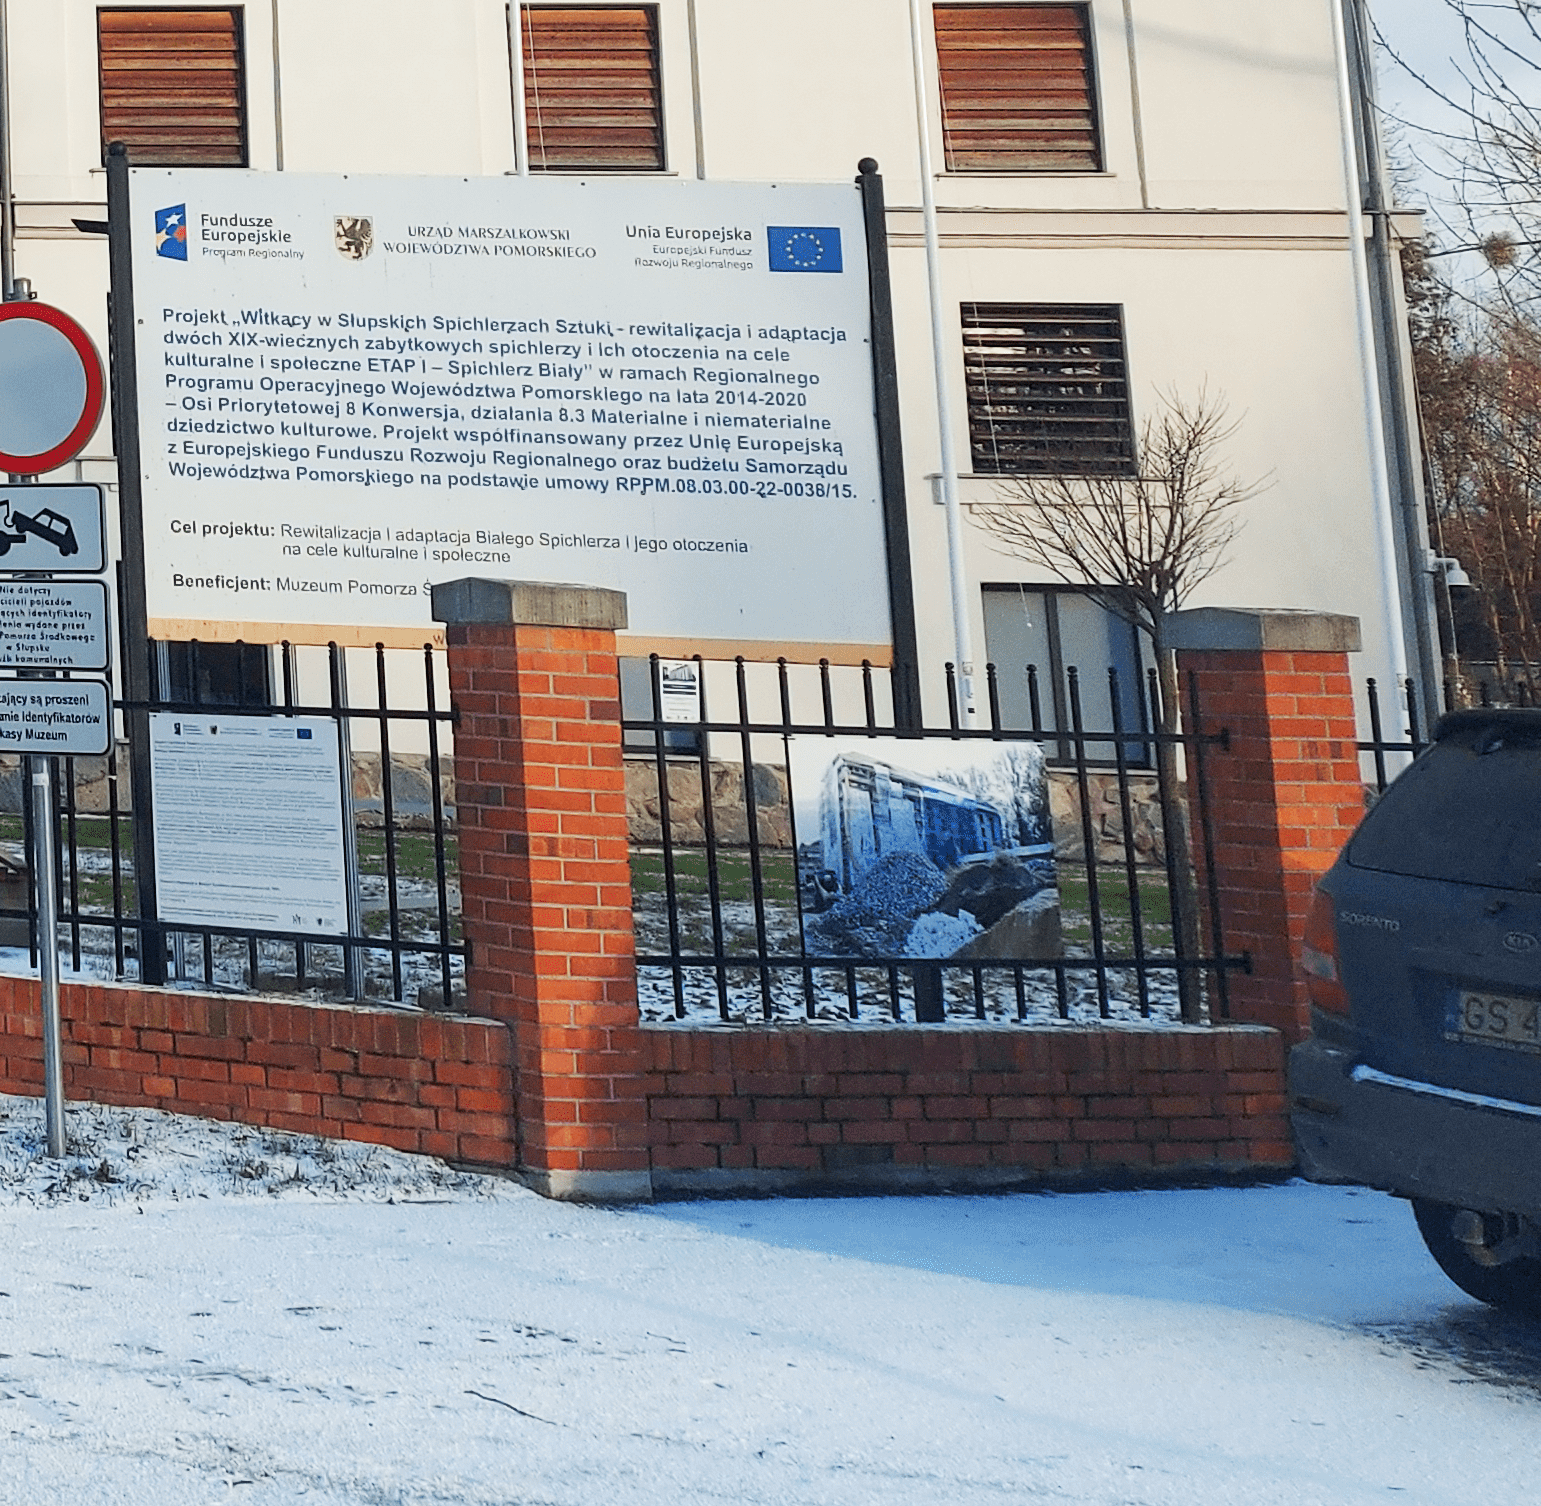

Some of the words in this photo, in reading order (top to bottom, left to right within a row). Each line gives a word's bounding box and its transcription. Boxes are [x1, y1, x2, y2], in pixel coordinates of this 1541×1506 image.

[201, 214, 273, 228] Fundusze
[202, 229, 292, 245] Europejskie
[408, 226, 453, 240] URZĄD
[626, 225, 660, 239] Unia
[665, 226, 751, 243] Europejska
[383, 241, 490, 255] WOJEWÓDZTWA
[494, 245, 596, 258] POMORSKIEGO
[163, 309, 229, 326] Projekt
[433, 316, 549, 334] Spichlerzach
[555, 319, 614, 336] Sztuki
[629, 322, 741, 340] rewitalizacja
[758, 325, 847, 344] adaptacja
[164, 331, 222, 346] dwóch
[228, 332, 359, 352] XIX-wiecznych
[365, 336, 482, 356] zabytkowych
[489, 340, 581, 359] spichlerzy
[632, 344, 719, 360] otoczenia
[726, 350, 747, 360] na
[754, 347, 790, 362] cele
[165, 353, 254, 369] kulturalne
[368, 359, 415, 373] ETAP
[448, 361, 534, 378] Spichlerz
[620, 367, 687, 381] ramach
[693, 367, 819, 386] Regionalnego
[166, 375, 253, 394] Programu
[260, 378, 385, 397] Operacyjnego
[391, 381, 515, 399] Województwa
[522, 384, 642, 403] Pomorskiego
[649, 392, 670, 403] na
[677, 388, 709, 404] lata
[715, 390, 806, 406] 2014-2020
[180, 397, 212, 412] Osi
[219, 398, 339, 419] Priorytetowej
[559, 407, 585, 423] 8.3
[592, 409, 687, 426] Materialne
[705, 412, 831, 430] niematerialne
[167, 419, 274, 436] dziedzictwo
[383, 425, 449, 444] Projekt
[634, 436, 684, 450] przez
[689, 434, 731, 452] Unię
[737, 435, 843, 455] Europejską
[183, 442, 310, 461] Europejskiego
[317, 445, 403, 461] Funduszu
[410, 448, 486, 468] Rozwoju
[493, 450, 617, 471] Regionalnego
[623, 458, 662, 469] oraz
[667, 455, 739, 472] budżetu
[745, 458, 848, 477] Samorządu
[169, 463, 290, 481] Województwa
[297, 466, 414, 487] Pomorskiego
[421, 474, 441, 485] na
[448, 472, 539, 490] podstawie
[545, 477, 609, 493] umowy
[171, 520, 196, 534] Cel
[281, 524, 381, 543] Rewitalizacja
[396, 528, 470, 546] adaptacja
[539, 533, 620, 550] Spichlerza
[635, 534, 667, 553] jego
[673, 536, 748, 554] otoczenia
[283, 545, 301, 555] na
[307, 544, 337, 556] cele
[344, 545, 418, 560] kulturalne
[277, 577, 342, 594] Muzeum
[348, 580, 417, 595] Pomorza
[45, 694, 89, 707] proszeni
[22, 711, 100, 726] identyfikatorów
[0, 727, 22, 742] kasy
[25, 728, 67, 742] Muzeum
[1340, 911, 1400, 930] SORENTO
